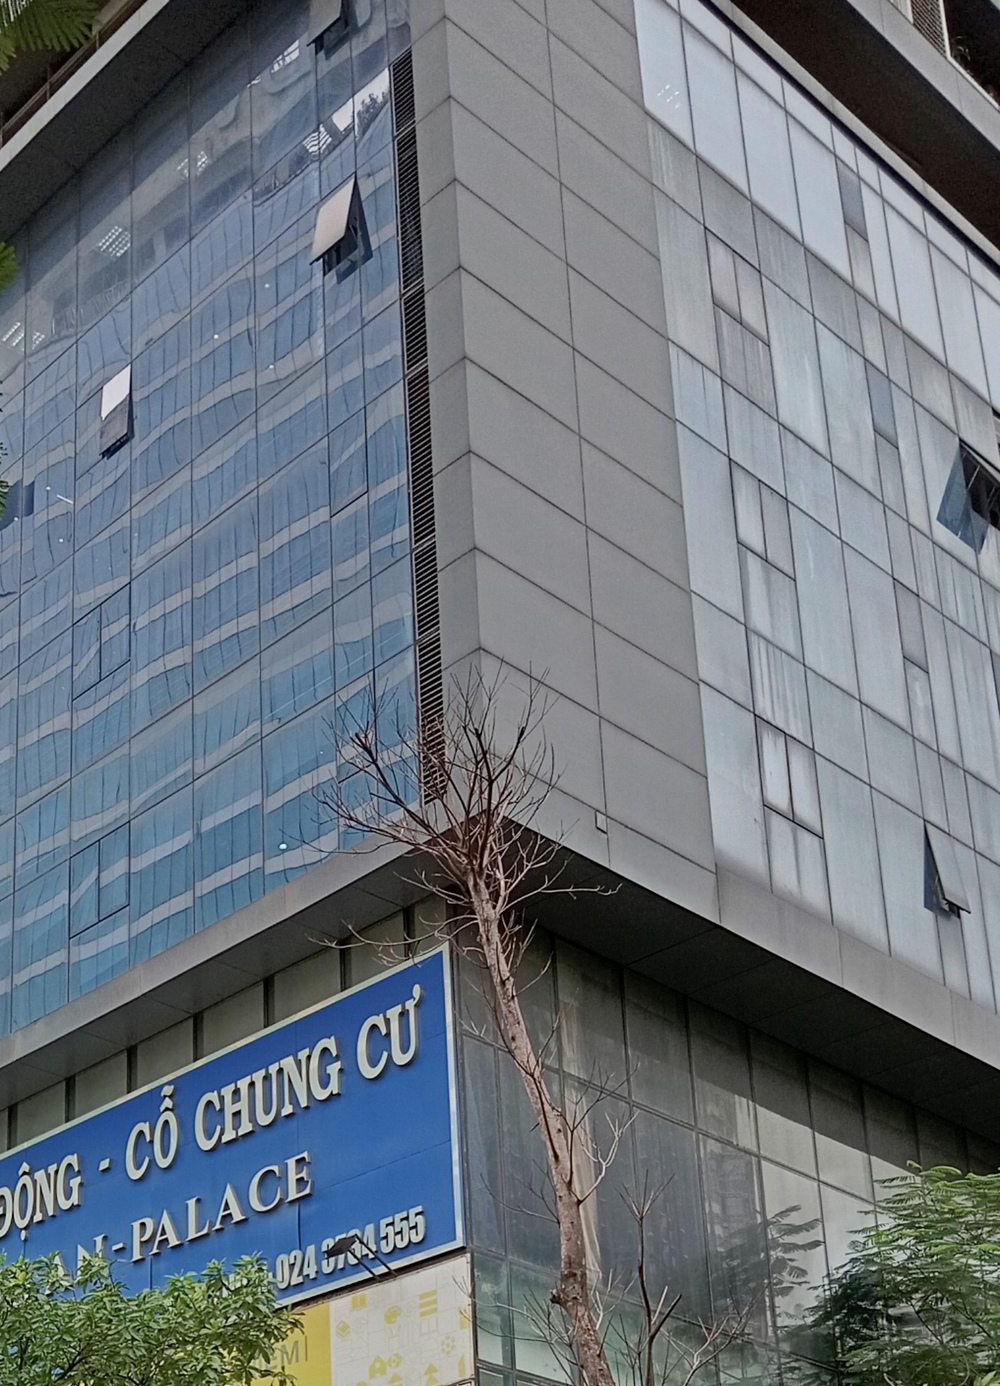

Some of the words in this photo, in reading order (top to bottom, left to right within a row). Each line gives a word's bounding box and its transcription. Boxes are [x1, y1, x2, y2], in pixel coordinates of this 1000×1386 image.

[125, 1085, 179, 1181] CỖ
[194, 1034, 343, 1153] CHUNG
[356, 984, 424, 1080] CƯ
[275, 1244, 318, 1289] 024
[379, 1205, 426, 1255] 555
